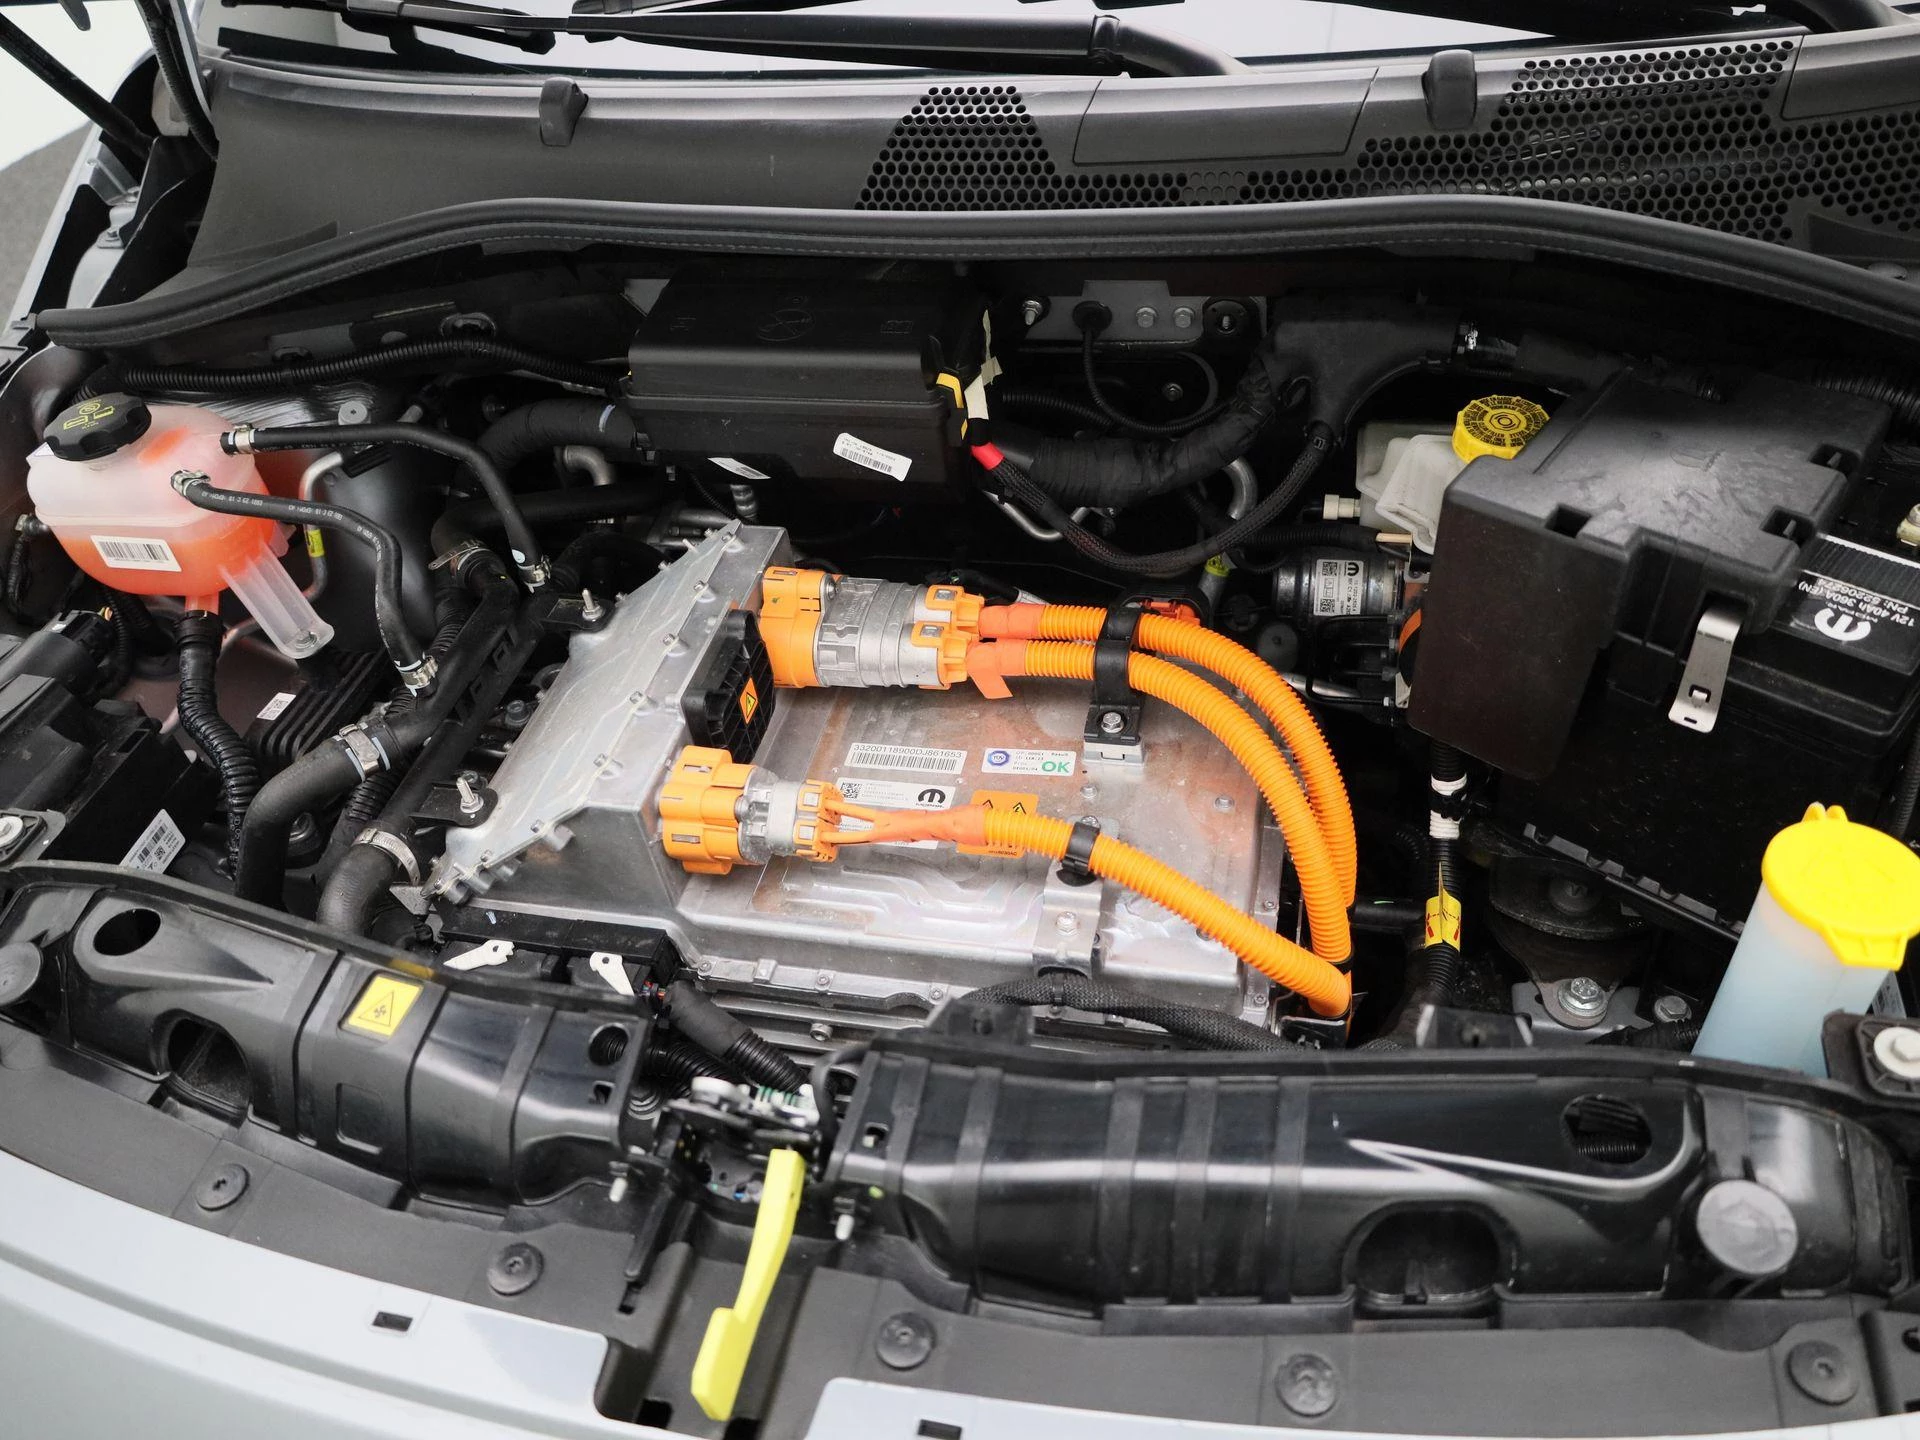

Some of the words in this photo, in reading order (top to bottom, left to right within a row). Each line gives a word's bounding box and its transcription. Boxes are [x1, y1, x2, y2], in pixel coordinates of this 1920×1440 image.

[1798, 580, 1825, 597] (EN)
[1817, 579, 1881, 602] 52206274
[1825, 592, 1857, 607] 360A
[1859, 602, 1890, 619] 40Ah
[1884, 600, 1909, 615] PN:
[1890, 613, 1915, 627] 12V
[1041, 760, 1071, 774] OK
